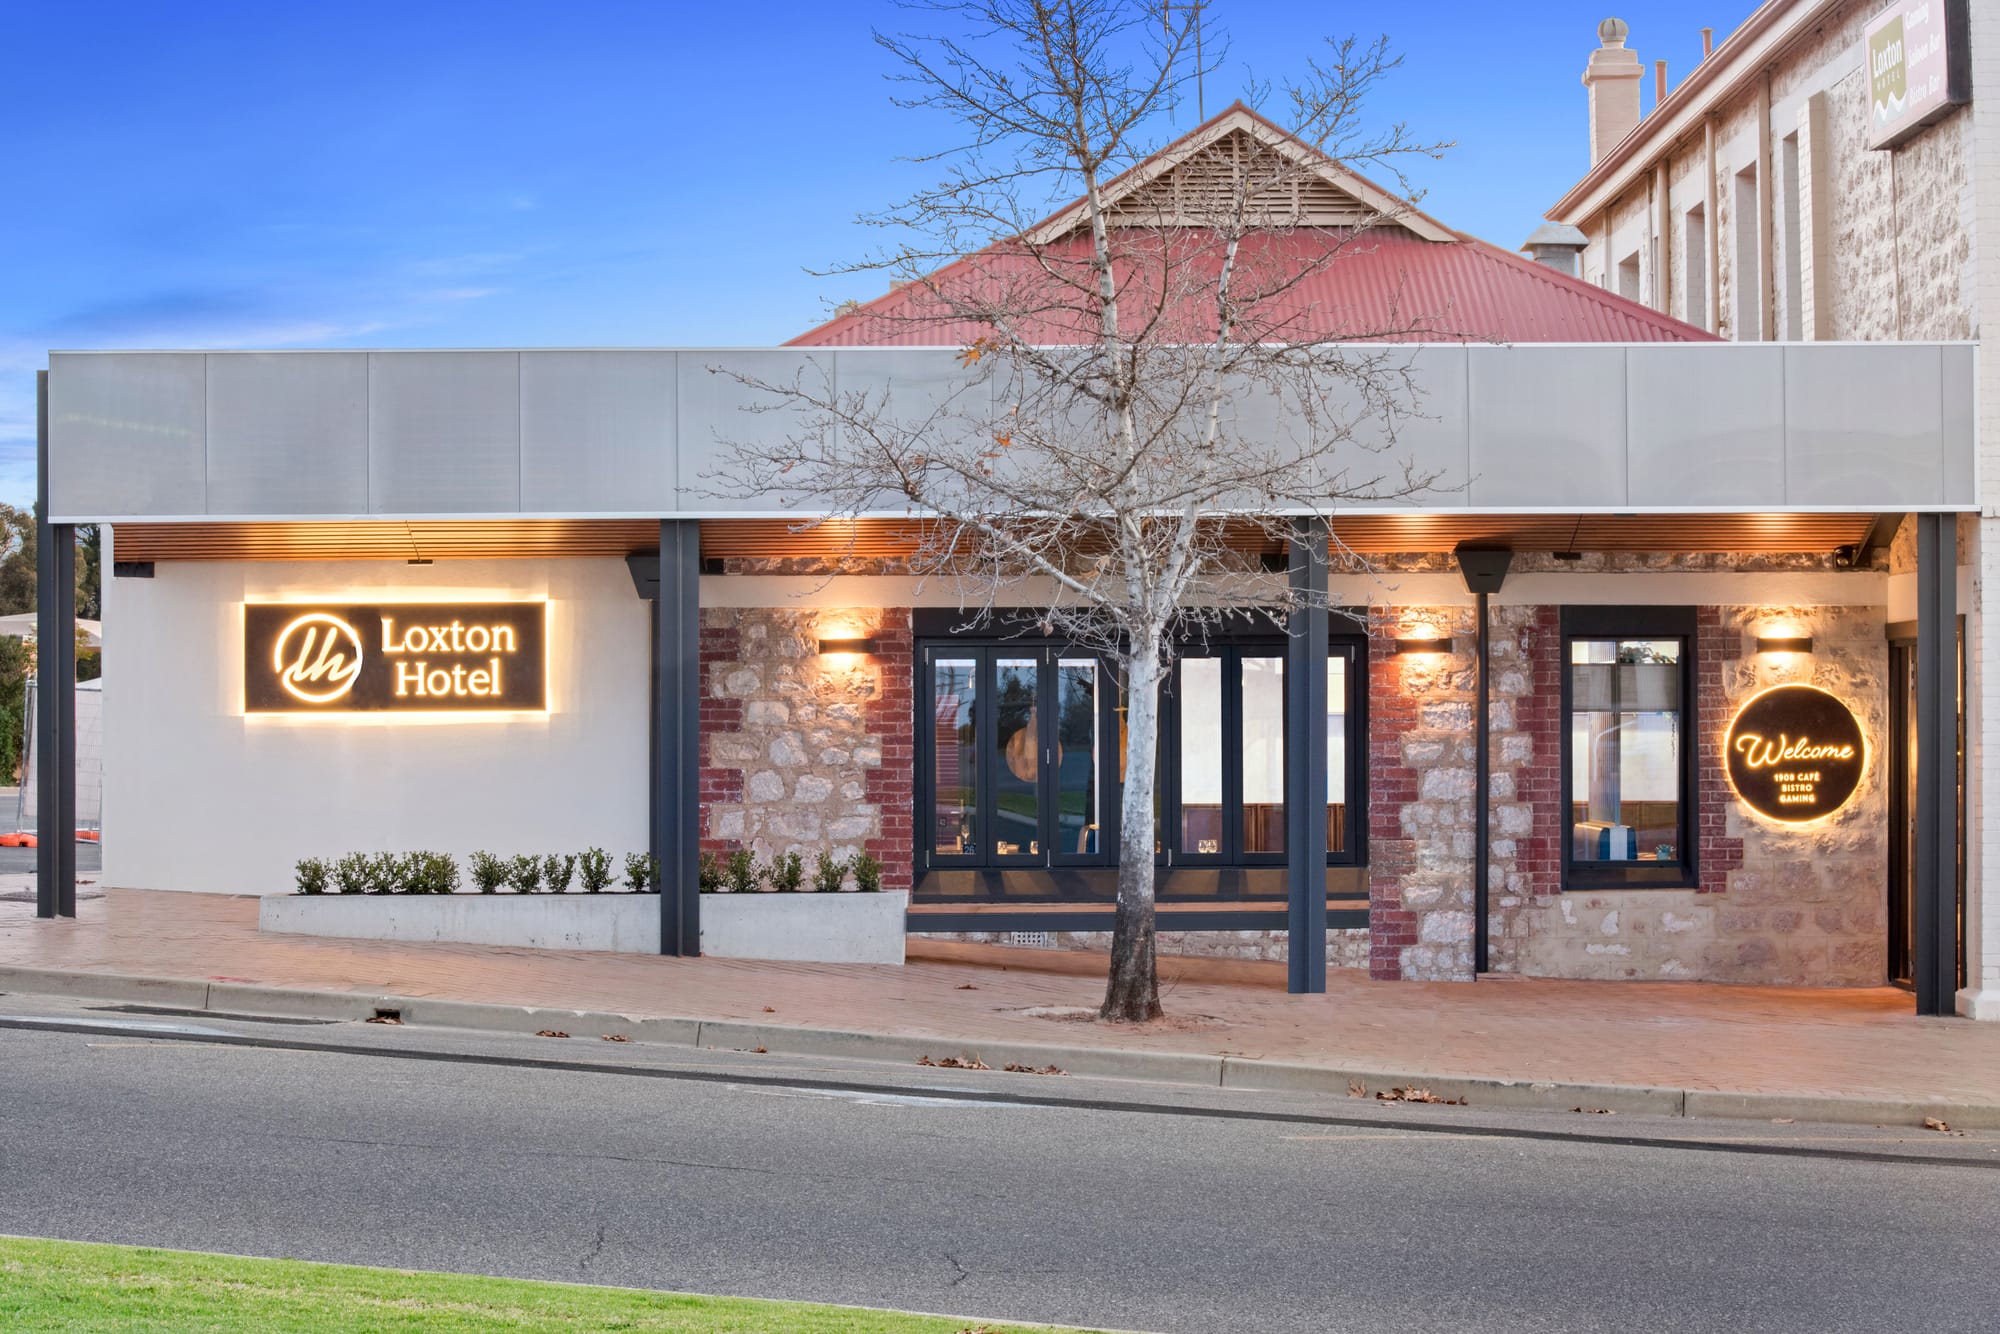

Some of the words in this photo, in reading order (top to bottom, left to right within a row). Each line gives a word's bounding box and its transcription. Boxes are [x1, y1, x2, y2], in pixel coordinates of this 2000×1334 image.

[1872, 39, 1903, 78] Loxton
[1909, 83, 1927, 108] Bistro
[381, 617, 516, 653] Loxton
[395, 657, 501, 696] Hotel
[1736, 733, 1854, 768] Welcome
[1779, 794, 1815, 804] GAMING
[1781, 783, 1813, 793] BISTRO
